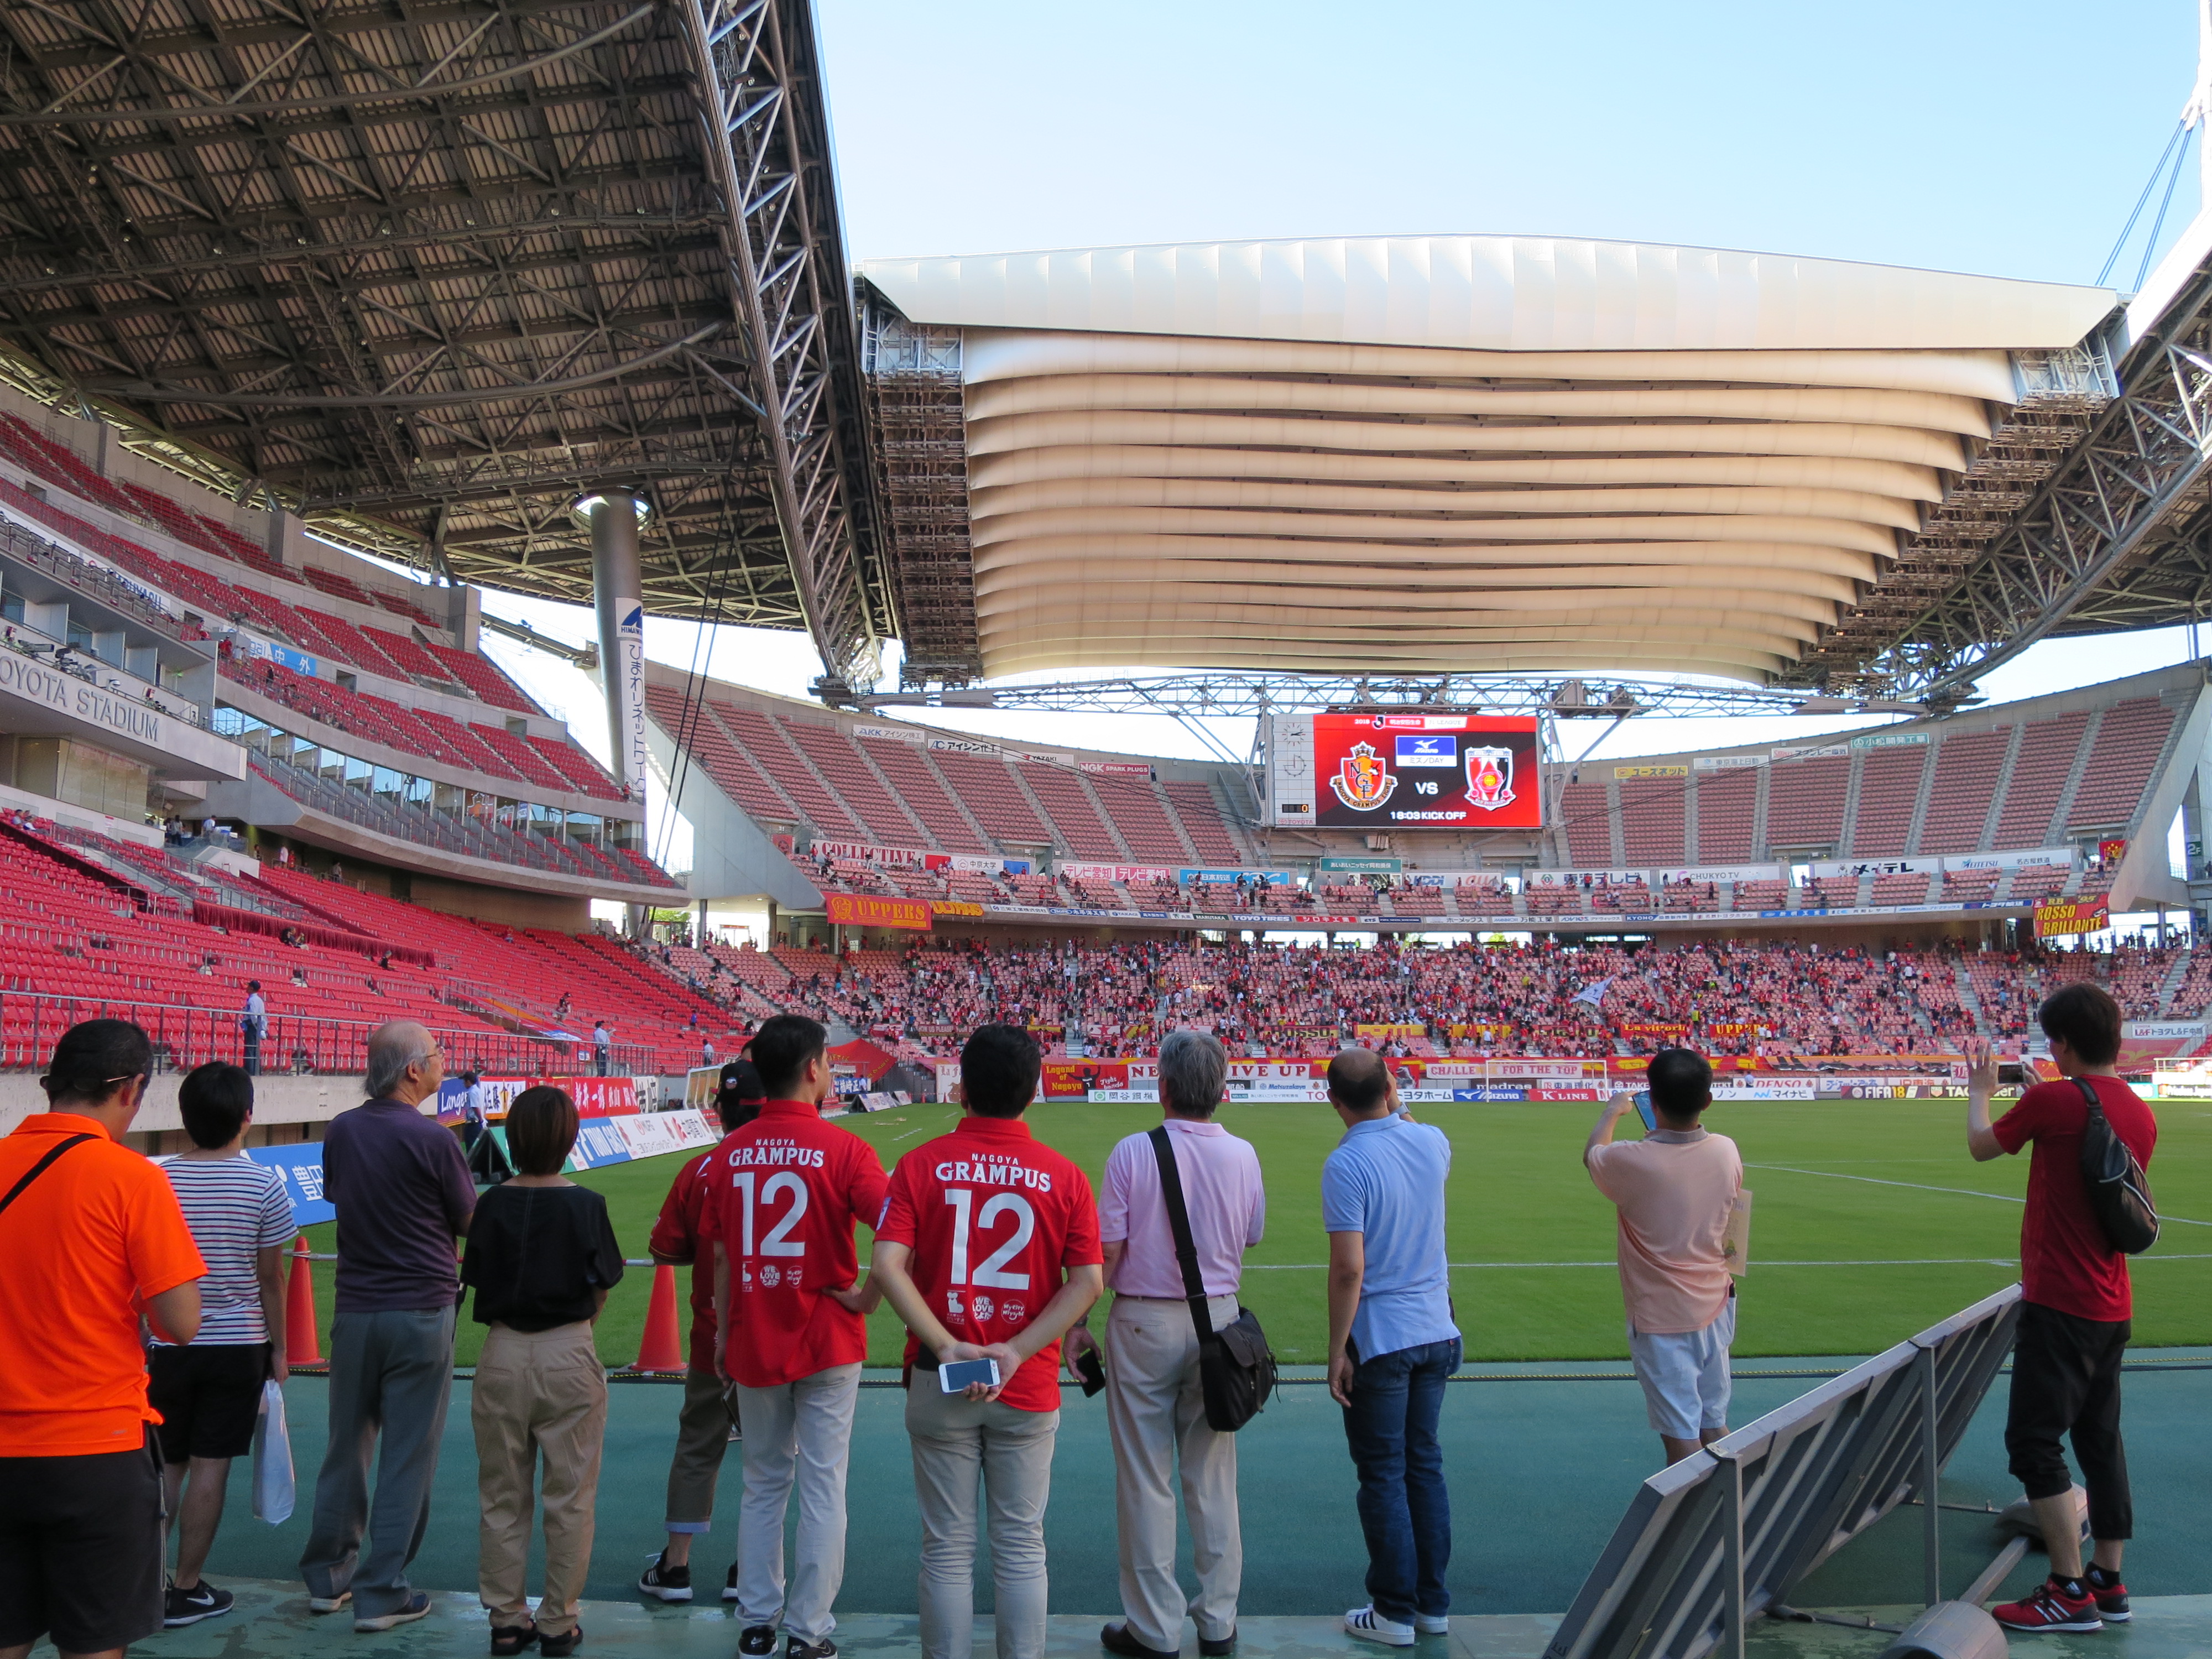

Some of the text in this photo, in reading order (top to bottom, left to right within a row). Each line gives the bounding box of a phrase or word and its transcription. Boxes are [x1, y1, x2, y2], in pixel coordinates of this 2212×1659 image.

[76, 688, 158, 742] STADIUM
[858, 728, 921, 739] AKK アイシン機工
[1866, 735, 1926, 747] 小松開発工業
[947, 742, 998, 753] アイシン化工
[1716, 757, 1759, 766] 東京海上日動
[1080, 763, 1104, 773] NGK
[1337, 780, 1392, 808] NAGOYA GRAMPUS EIGHT
[1415, 782, 1438, 795] VS
[1390, 811, 1467, 820] 18:03 KICK OFF
[822, 842, 916, 864] COLLECTIVE
[2187, 843, 2201, 855] 2F
[969, 860, 997, 869] 中京大学
[1066, 865, 1112, 879] テレビ愛知
[1119, 867, 1166, 881] テレビ愛知
[1690, 872, 1726, 880] CHUKYO
[1235, 872, 1281, 885] CBC
[1414, 875, 1445, 885] KDDI
[857, 900, 926, 920] UPPERS
[2036, 905, 2077, 921] ROSSO
[2042, 917, 2102, 936] BRILLANTE
[1046, 1065, 1075, 1075] Legend
[1232, 1065, 1269, 1077] IVE
[1279, 1065, 1306, 1077] UP
[1503, 1065, 1524, 1074] FOR
[1529, 1065, 1551, 1074] THE
[1557, 1065, 1578, 1075] TOP
[1052, 1082, 1082, 1092] Nagoya
[1109, 1092, 1154, 1100] 岡谷鋼機
[1772, 1090, 1808, 1098] マイナビ
[728, 1147, 825, 1168] GRAMPUS
[972, 1153, 1019, 1166] NAGOYA
[935, 1161, 1052, 1193] GRAMPUS
[733, 1171, 808, 1256] 12
[945, 1188, 1035, 1291] 12
[975, 1297, 989, 1305] WE
[972, 1305, 994, 1313] LOVE
